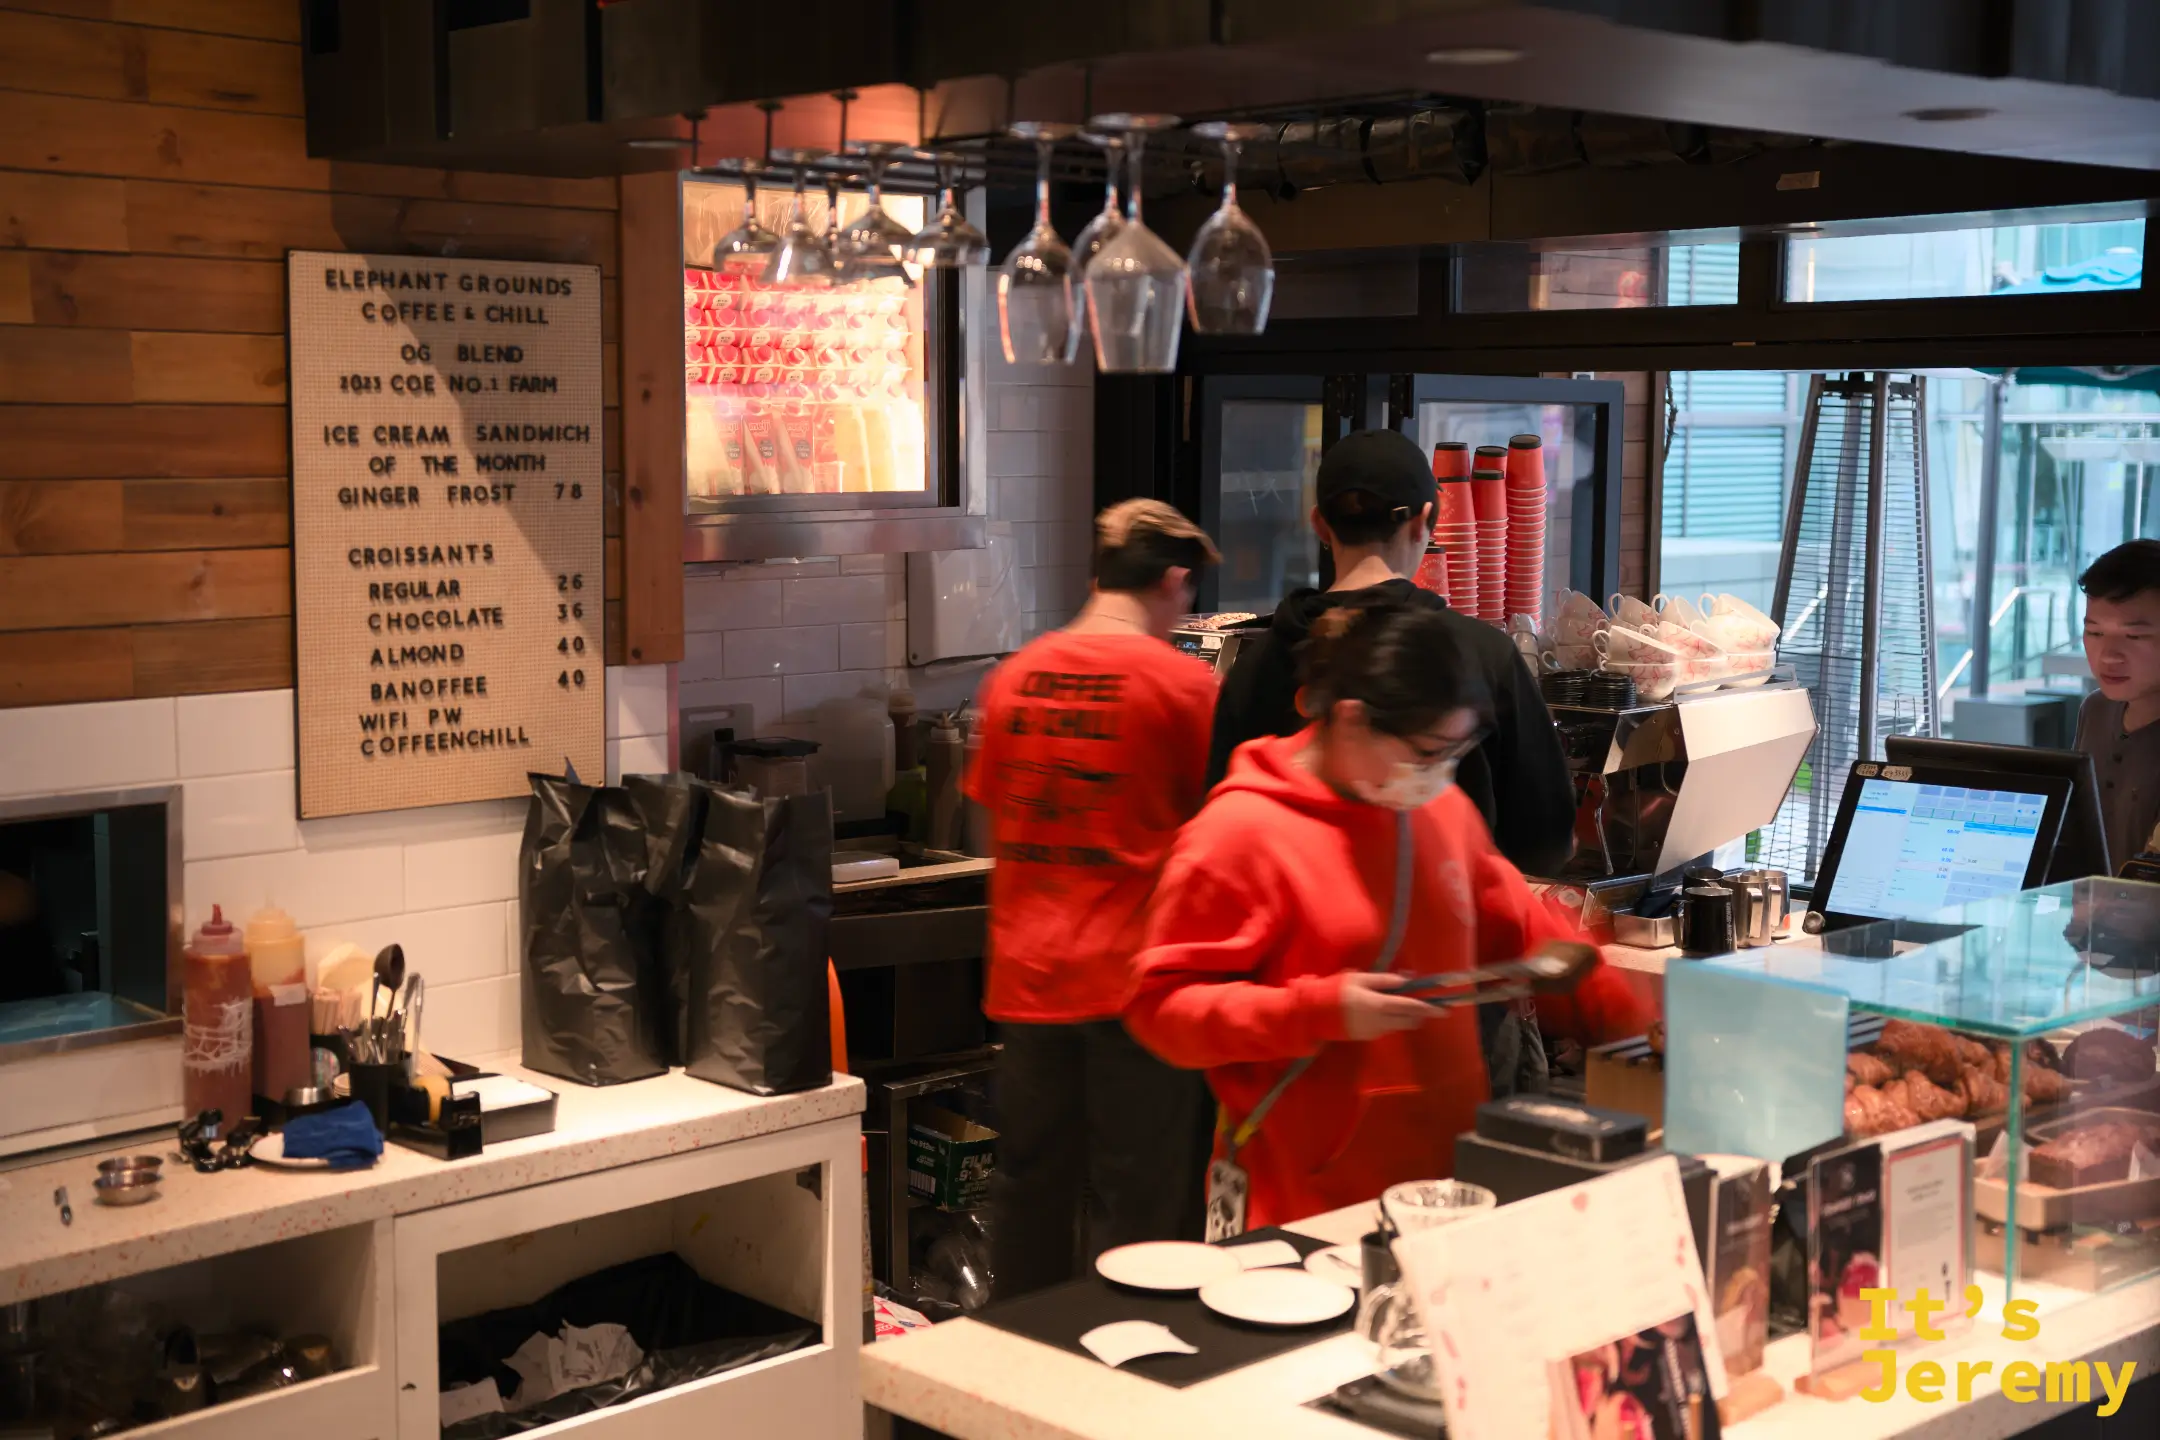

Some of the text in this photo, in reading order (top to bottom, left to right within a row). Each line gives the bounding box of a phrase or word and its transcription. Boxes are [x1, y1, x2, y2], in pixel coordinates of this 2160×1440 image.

[325, 269, 572, 295] ELEPHANT GROUNDS
[362, 302, 548, 324] COFFEE & CHILL
[401, 344, 523, 363] OG BLEND
[391, 375, 435, 392] COE
[510, 377, 557, 392] FARM
[324, 425, 590, 444] ICE CREAM SANDWICH
[369, 455, 546, 474] OF THE MONTH
[338, 486, 419, 505] GINGER
[447, 484, 516, 504] FROST
[349, 544, 494, 566] CROISSANTS
[369, 580, 461, 600] REGULAR
[368, 607, 503, 631] CHOCOLATE
[371, 644, 464, 666] ALMOND
[371, 676, 487, 700] BANOFFEE
[360, 712, 408, 731] WIFI
[361, 726, 529, 755] COFFEENCHILL
